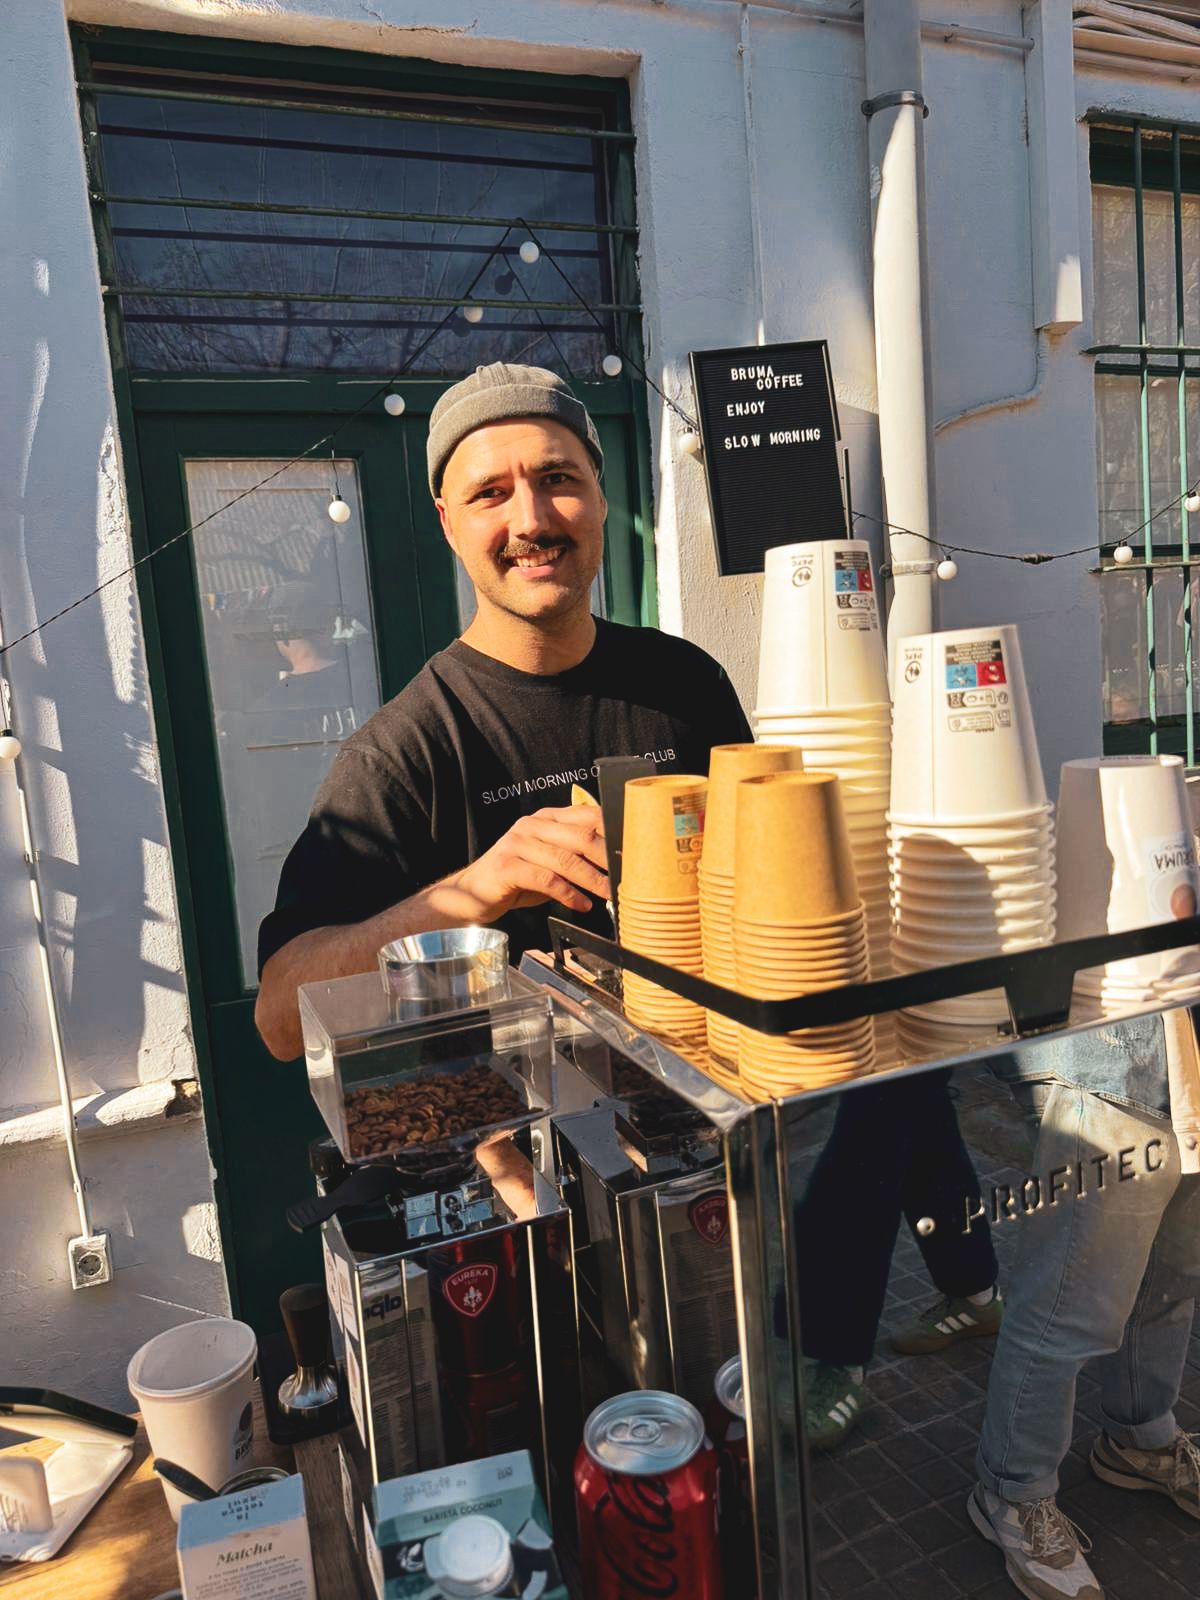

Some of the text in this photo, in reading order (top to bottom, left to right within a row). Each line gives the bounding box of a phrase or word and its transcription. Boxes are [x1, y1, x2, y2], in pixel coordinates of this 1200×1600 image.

[731, 365, 774, 381] BRUMA
[756, 374, 804, 391] COFFEE
[726, 401, 765, 417] ENJOY
[724, 428, 821, 450] SLOW MORNING
[482, 748, 676, 805] SLOW MORNING CLUB
[961, 1138, 1166, 1235] PROFITEC
[451, 1268, 489, 1287] EUREKA
[422, 1497, 503, 1524] BARISTA COCONUT
[216, 1542, 274, 1567] Matcha
